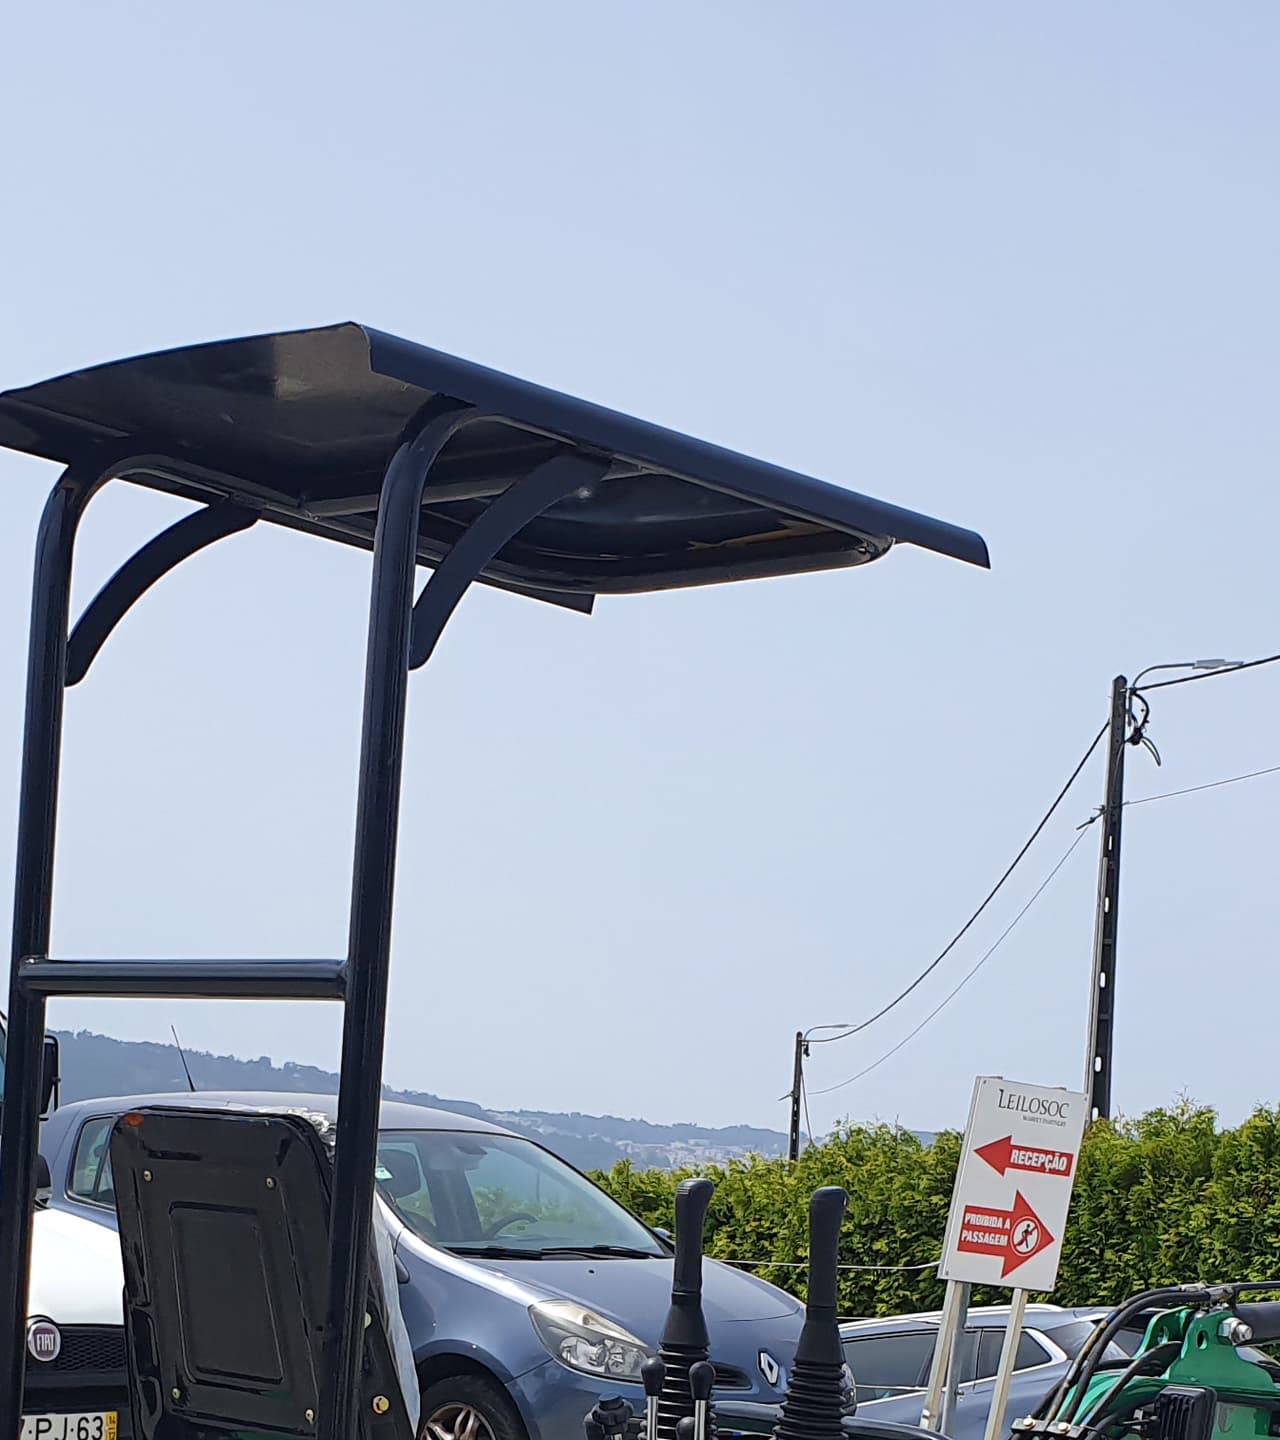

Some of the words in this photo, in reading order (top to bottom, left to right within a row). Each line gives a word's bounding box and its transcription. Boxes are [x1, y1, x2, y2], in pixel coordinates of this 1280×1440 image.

[1010, 1149, 1067, 1172] RECEPÇÃO
[964, 1212, 1004, 1229] PROIBIDA
[1004, 1217, 1011, 1230] A
[960, 1231, 1009, 1246] PASSAGEM
[36, 1334, 55, 1351] FIAT
